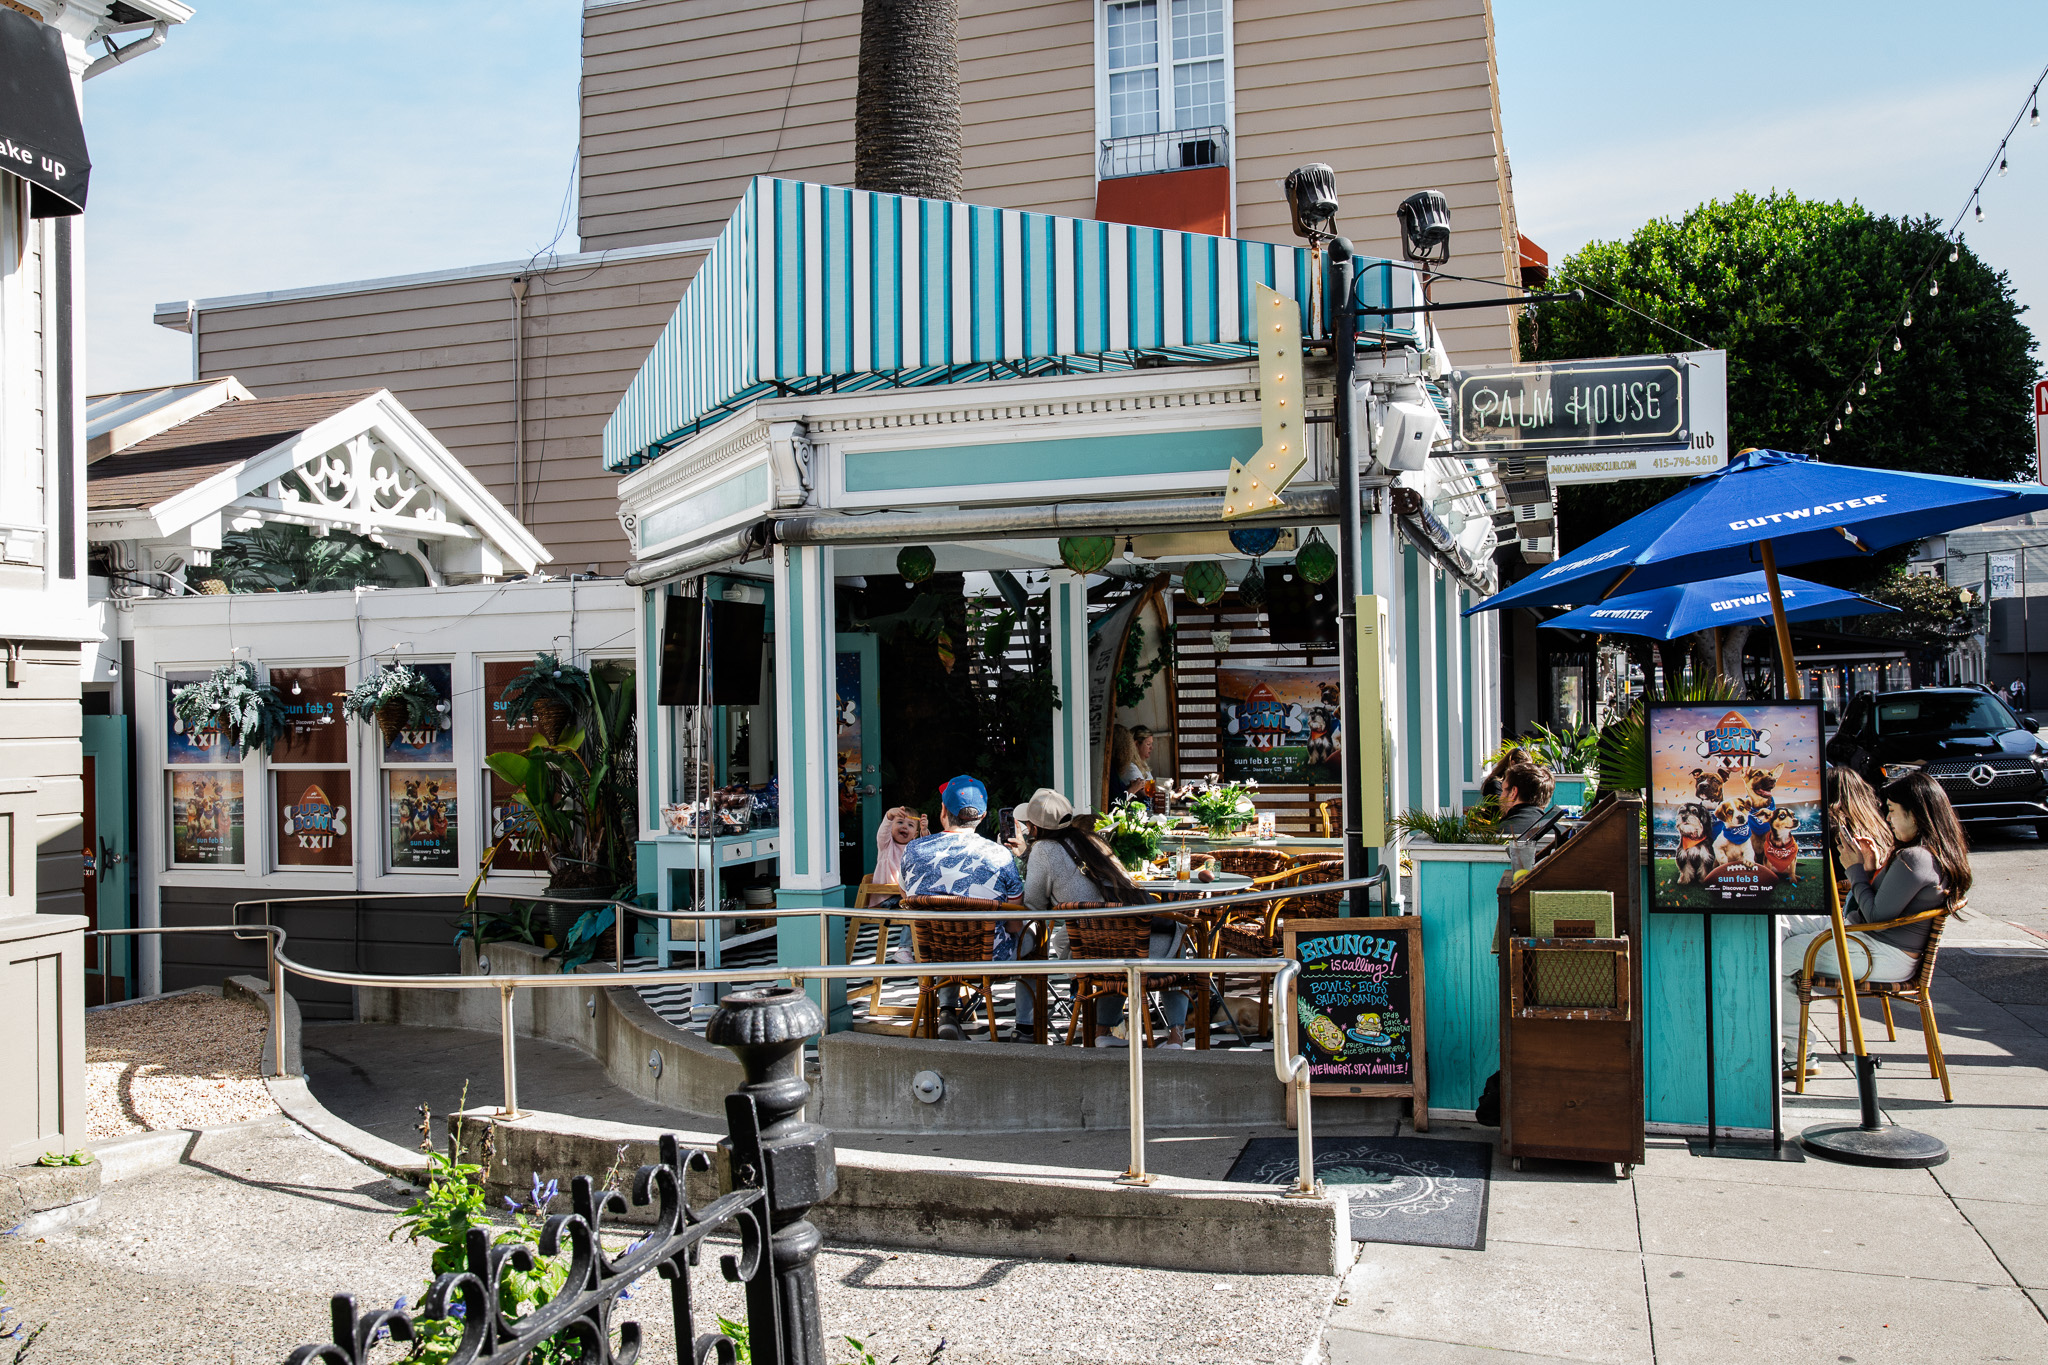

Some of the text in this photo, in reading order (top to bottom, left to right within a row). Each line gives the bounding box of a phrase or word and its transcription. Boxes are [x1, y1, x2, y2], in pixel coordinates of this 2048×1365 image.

[42, 156, 67, 181] up
[1472, 381, 1661, 429] PALM HOUSE
[1690, 431, 1714, 450] lub
[1652, 454, 1719, 469] 415-796-3610
[1728, 494, 1887, 531] CUTWATER
[1710, 589, 1796, 612] CUTWATR
[1590, 609, 1651, 620] CUTWATER
[284, 705, 303, 714] sun
[305, 702, 324, 714] feb
[1235, 701, 1295, 718] PUPPY
[1239, 713, 1291, 731] BOWL
[186, 733, 222, 747] XXII
[399, 730, 437, 745] XXII
[1244, 733, 1286, 748] XXII
[1704, 727, 1764, 741] PUPPY
[1708, 738, 1761, 754] BOWL
[1249, 757, 1263, 765] feb
[1264, 757, 1270, 765] 8
[1714, 755, 1756, 768] XXII
[290, 803, 340, 818] PUPPY
[294, 816, 338, 832] BOWL
[208, 836, 219, 844] feb
[298, 835, 334, 849] XXII
[435, 839, 440, 847] 8
[1736, 875, 1751, 883] feb
[1752, 875, 1759, 883] 8
[1297, 934, 1398, 963] BRUNCH
[1330, 952, 1399, 984] is calling!
[1309, 980, 1389, 995] BOWLS EGGS
[1315, 993, 1389, 1007] SALADS SANDOS
[1353, 1063, 1372, 1076] STAY
